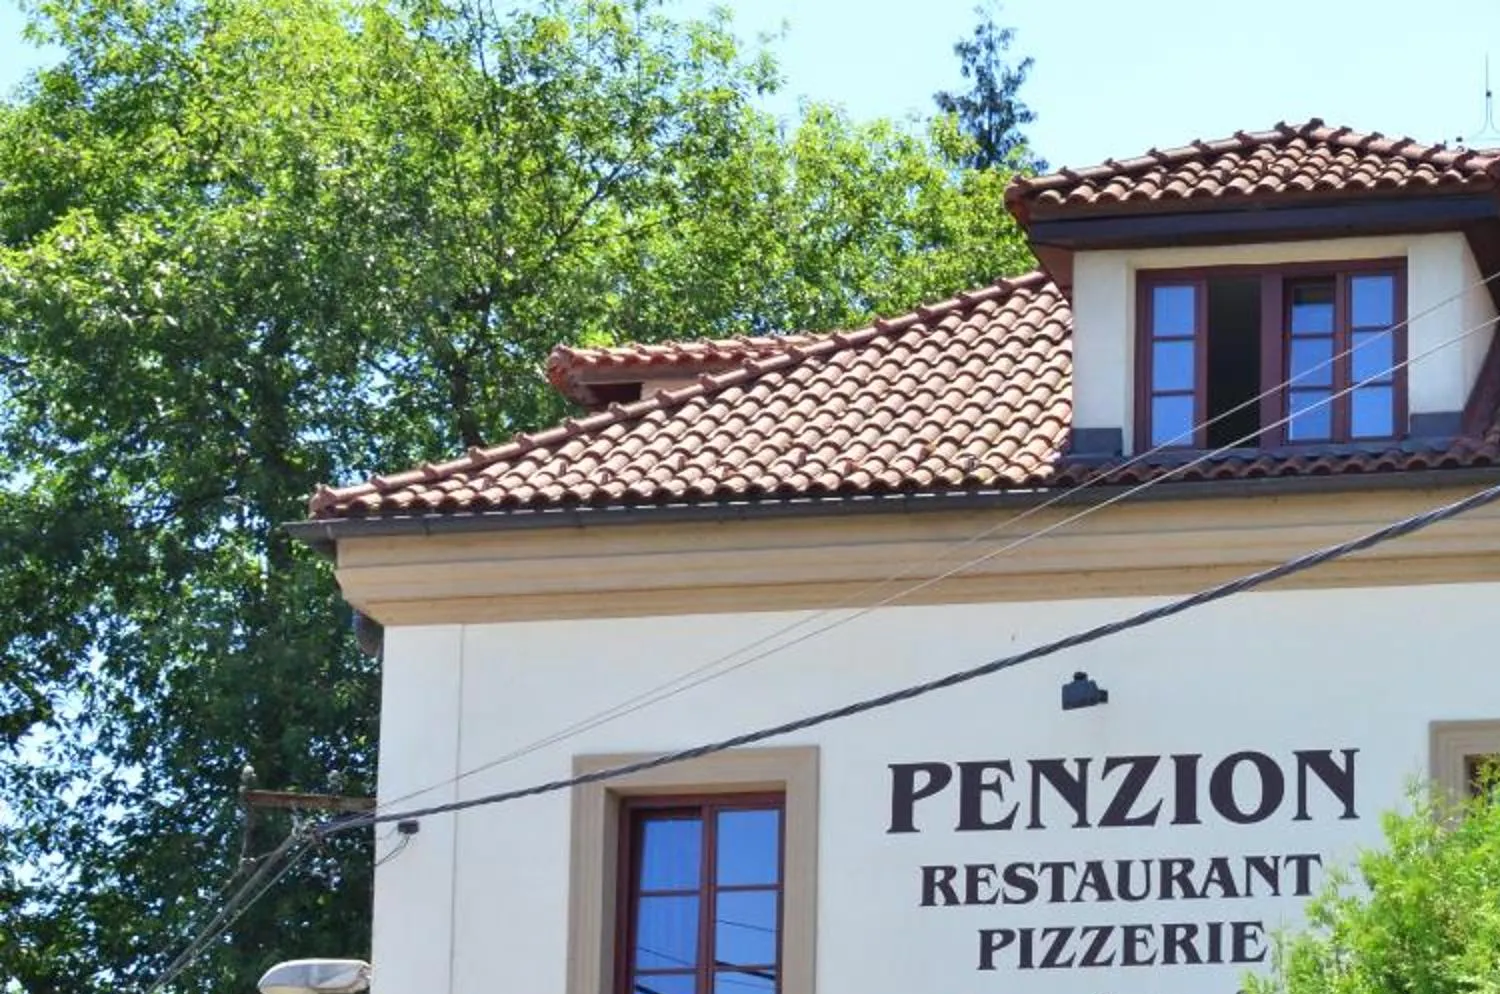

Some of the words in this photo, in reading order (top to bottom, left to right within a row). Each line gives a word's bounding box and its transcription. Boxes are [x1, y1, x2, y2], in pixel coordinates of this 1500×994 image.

[886, 748, 1360, 834] PENZION
[919, 853, 1322, 906] RESTAURANT
[977, 920, 1268, 970] PIZZERIE
